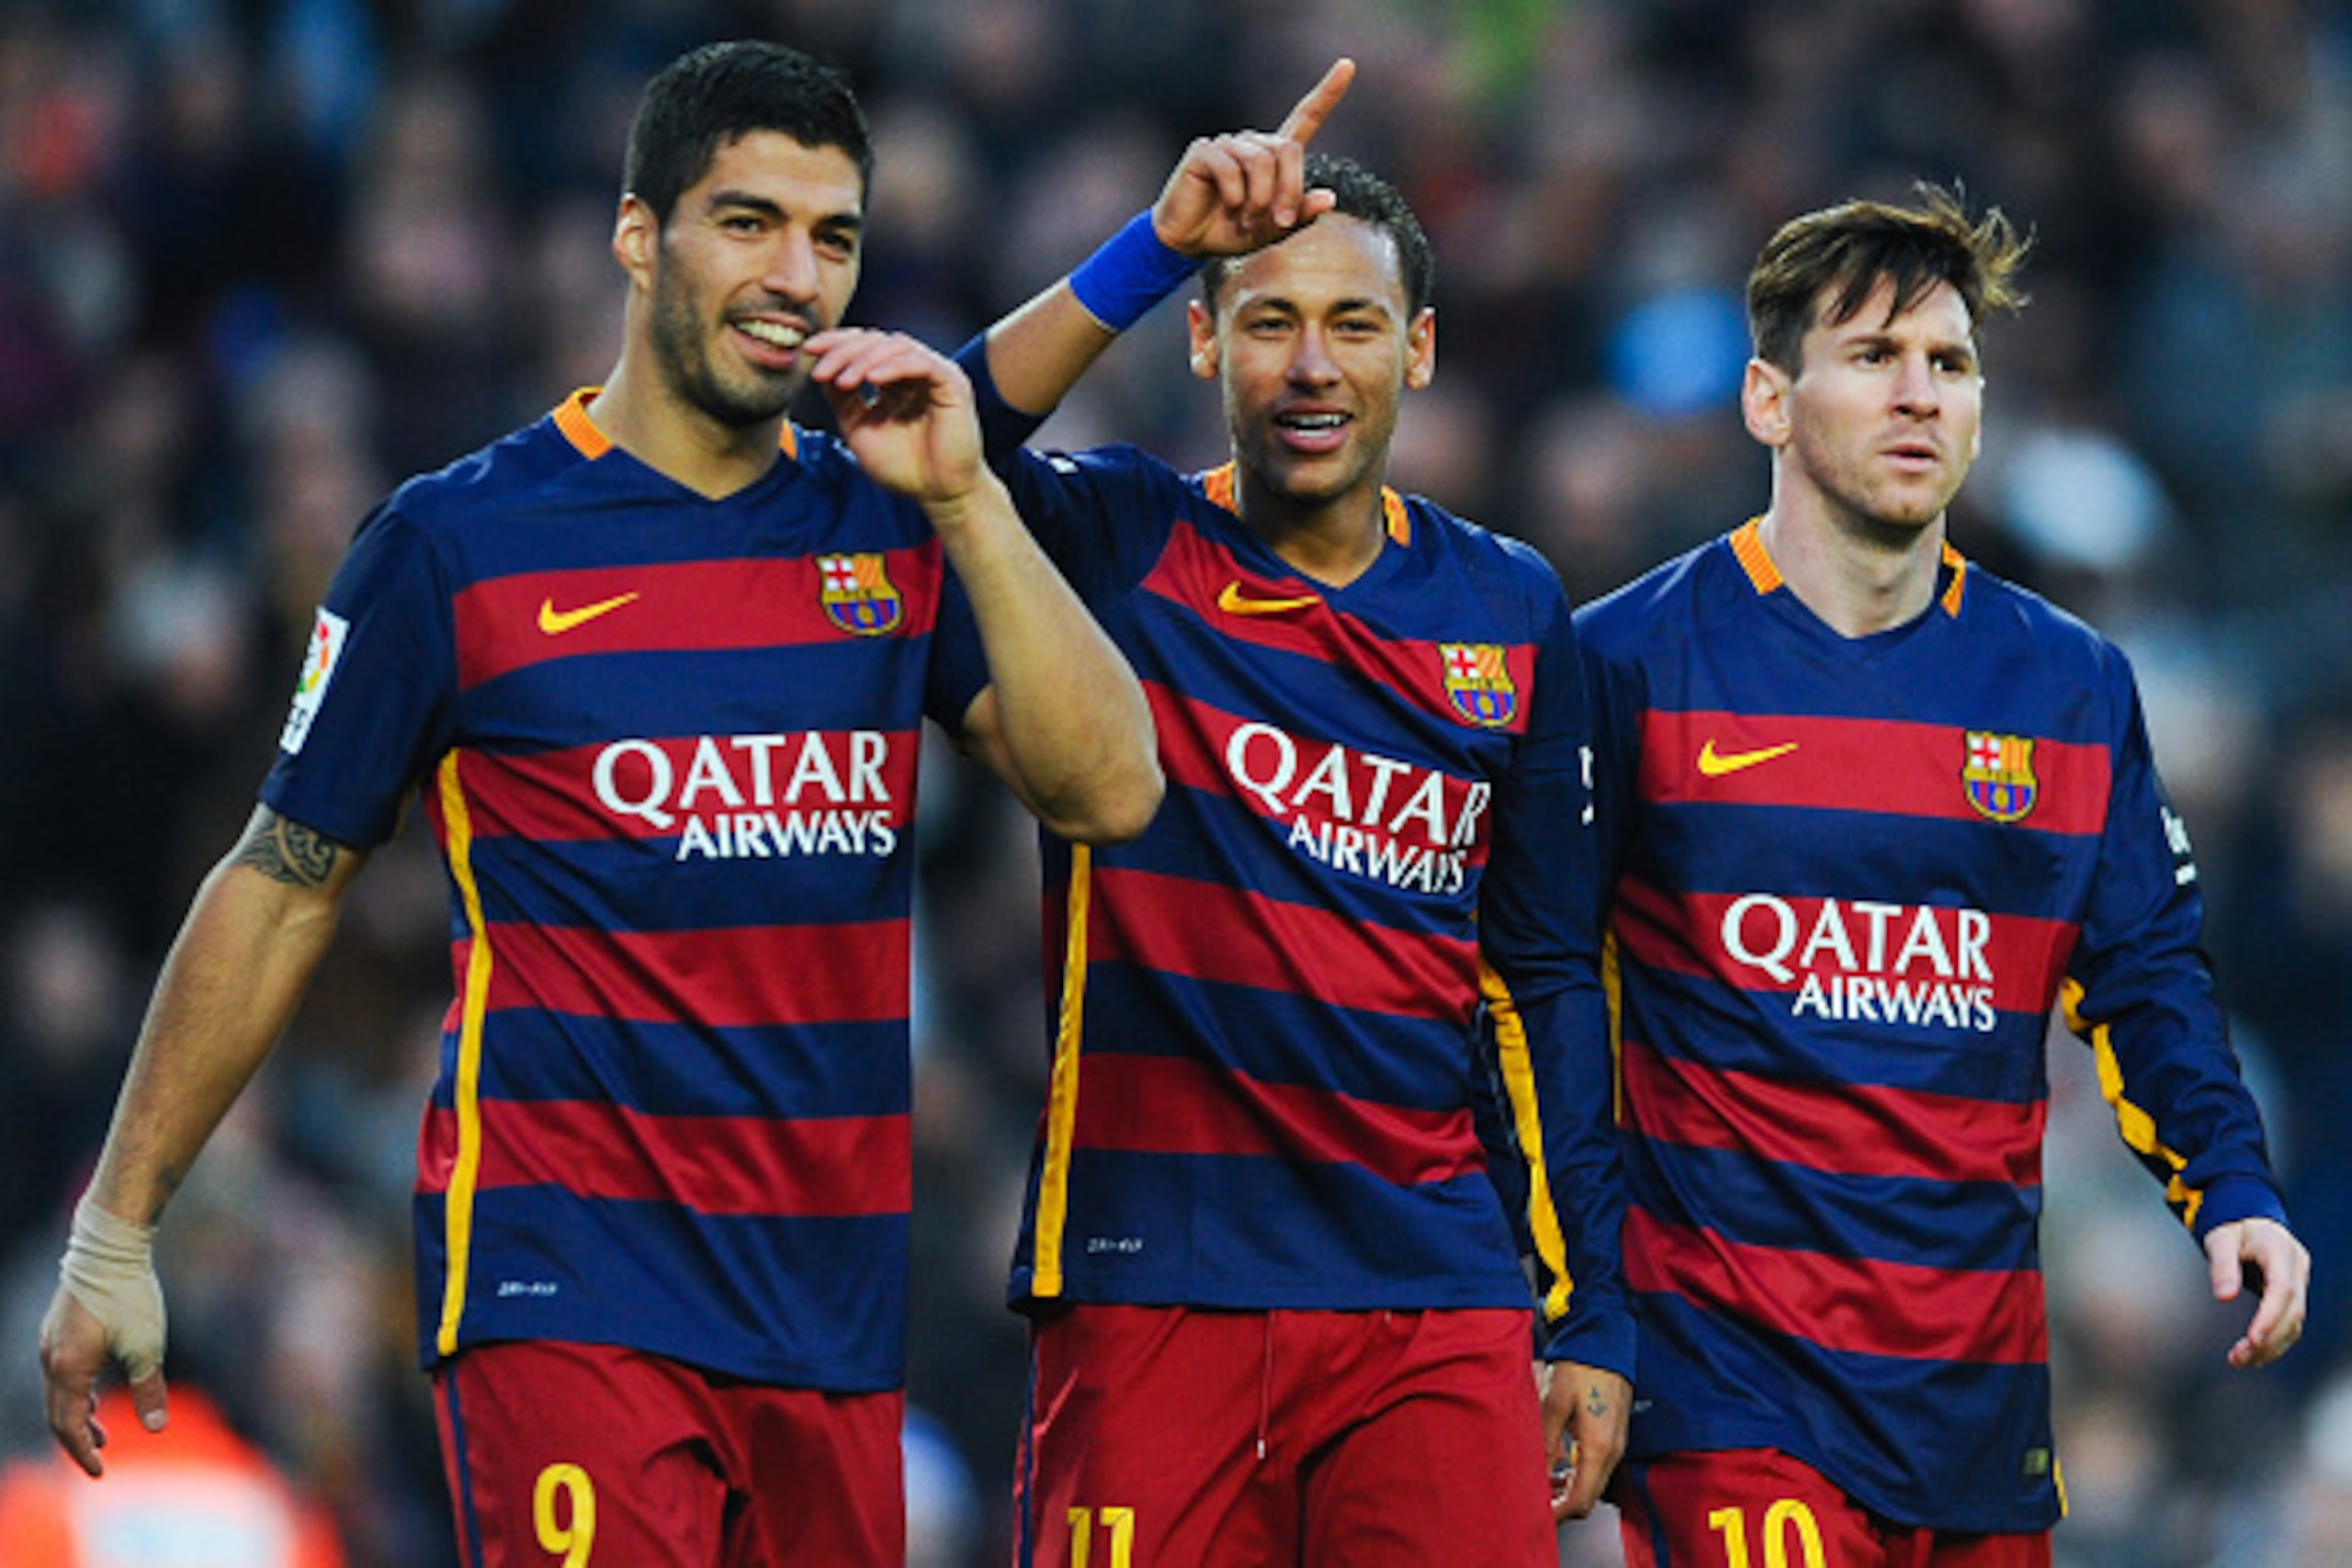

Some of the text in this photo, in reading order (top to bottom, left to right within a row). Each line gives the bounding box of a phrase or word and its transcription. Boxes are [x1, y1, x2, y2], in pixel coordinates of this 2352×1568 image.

[592, 729, 890, 830] QATAR
[1225, 721, 1491, 847] QATAR
[676, 807, 897, 862] AIRWAYS
[1288, 814, 1467, 894] AIRWAYS
[1720, 892, 1995, 984] QATAR
[1792, 971, 1996, 1032] AIRWAYS
[533, 1462, 596, 1568] 9
